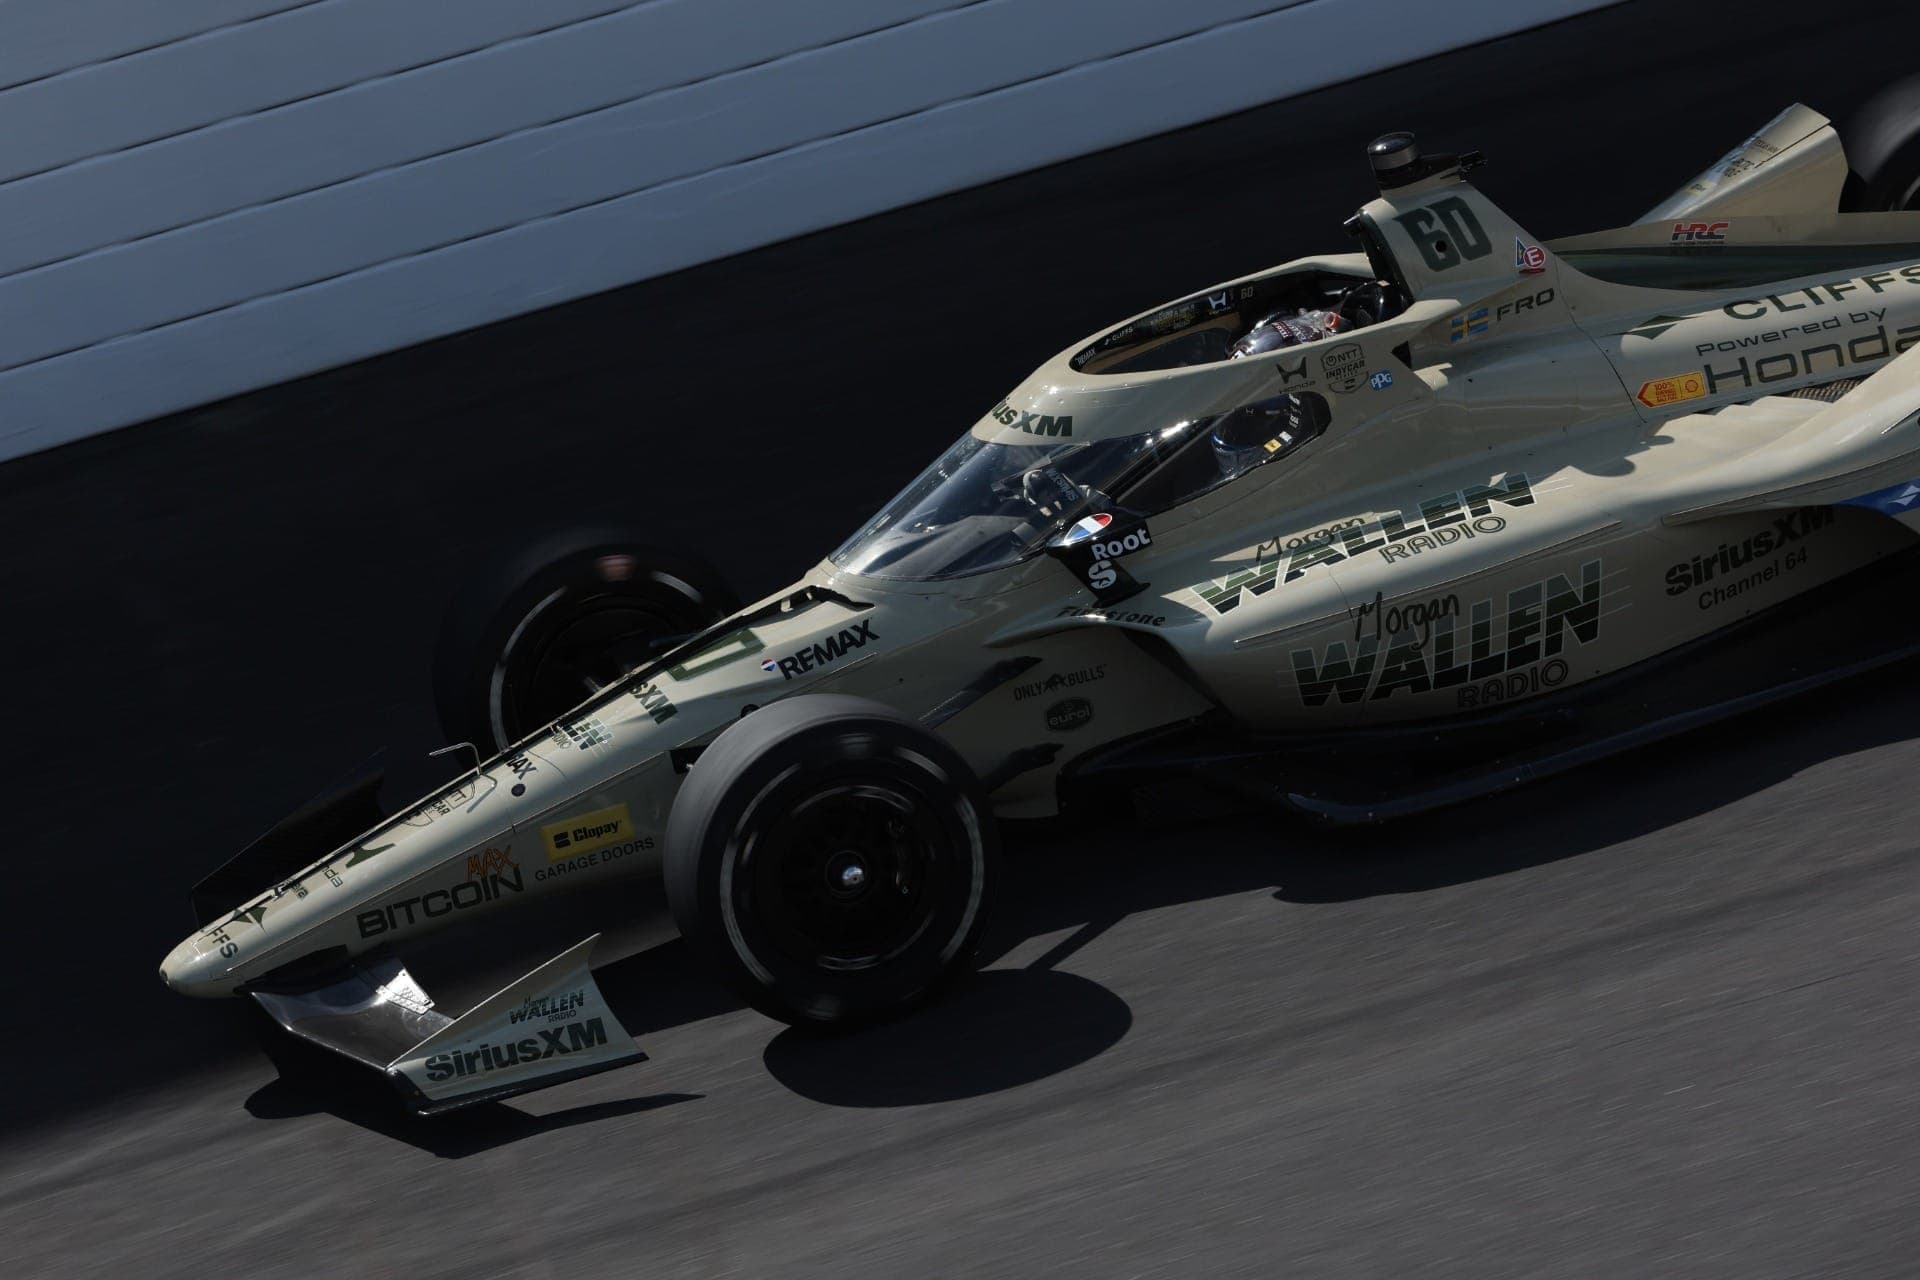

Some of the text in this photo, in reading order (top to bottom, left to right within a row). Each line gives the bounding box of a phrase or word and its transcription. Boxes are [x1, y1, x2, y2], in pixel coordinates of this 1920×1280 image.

[1393, 196, 1492, 272] 60
[1671, 221, 1729, 241] HRC
[1497, 288, 1555, 321] FRO
[1696, 307, 1887, 357] Powered by
[1326, 360, 1366, 380] INDYCAR
[1335, 348, 1358, 363] NTT
[1090, 528, 1152, 561] Root
[1191, 471, 1536, 616] WALLEN
[1256, 517, 1366, 561] Morgan
[1378, 515, 1507, 565] RADIO
[1664, 504, 1836, 598] SiriusXM
[1698, 546, 1809, 611] Channel 64
[1289, 558, 1602, 708] WALLEN
[1354, 591, 1460, 653] Morgan
[1014, 665, 1105, 701] ONLY BULLS
[1456, 658, 1569, 709] RADIO
[1048, 703, 1090, 726] eurol
[573, 820, 620, 844] Clopay
[467, 844, 519, 882] MAX
[535, 836, 656, 882] GARAGE DOORS
[356, 867, 525, 939] BITCOIN
[510, 988, 584, 1025] WALLEN
[547, 1008, 578, 1024] RADIO
[424, 1017, 608, 1082] SiriusXM
